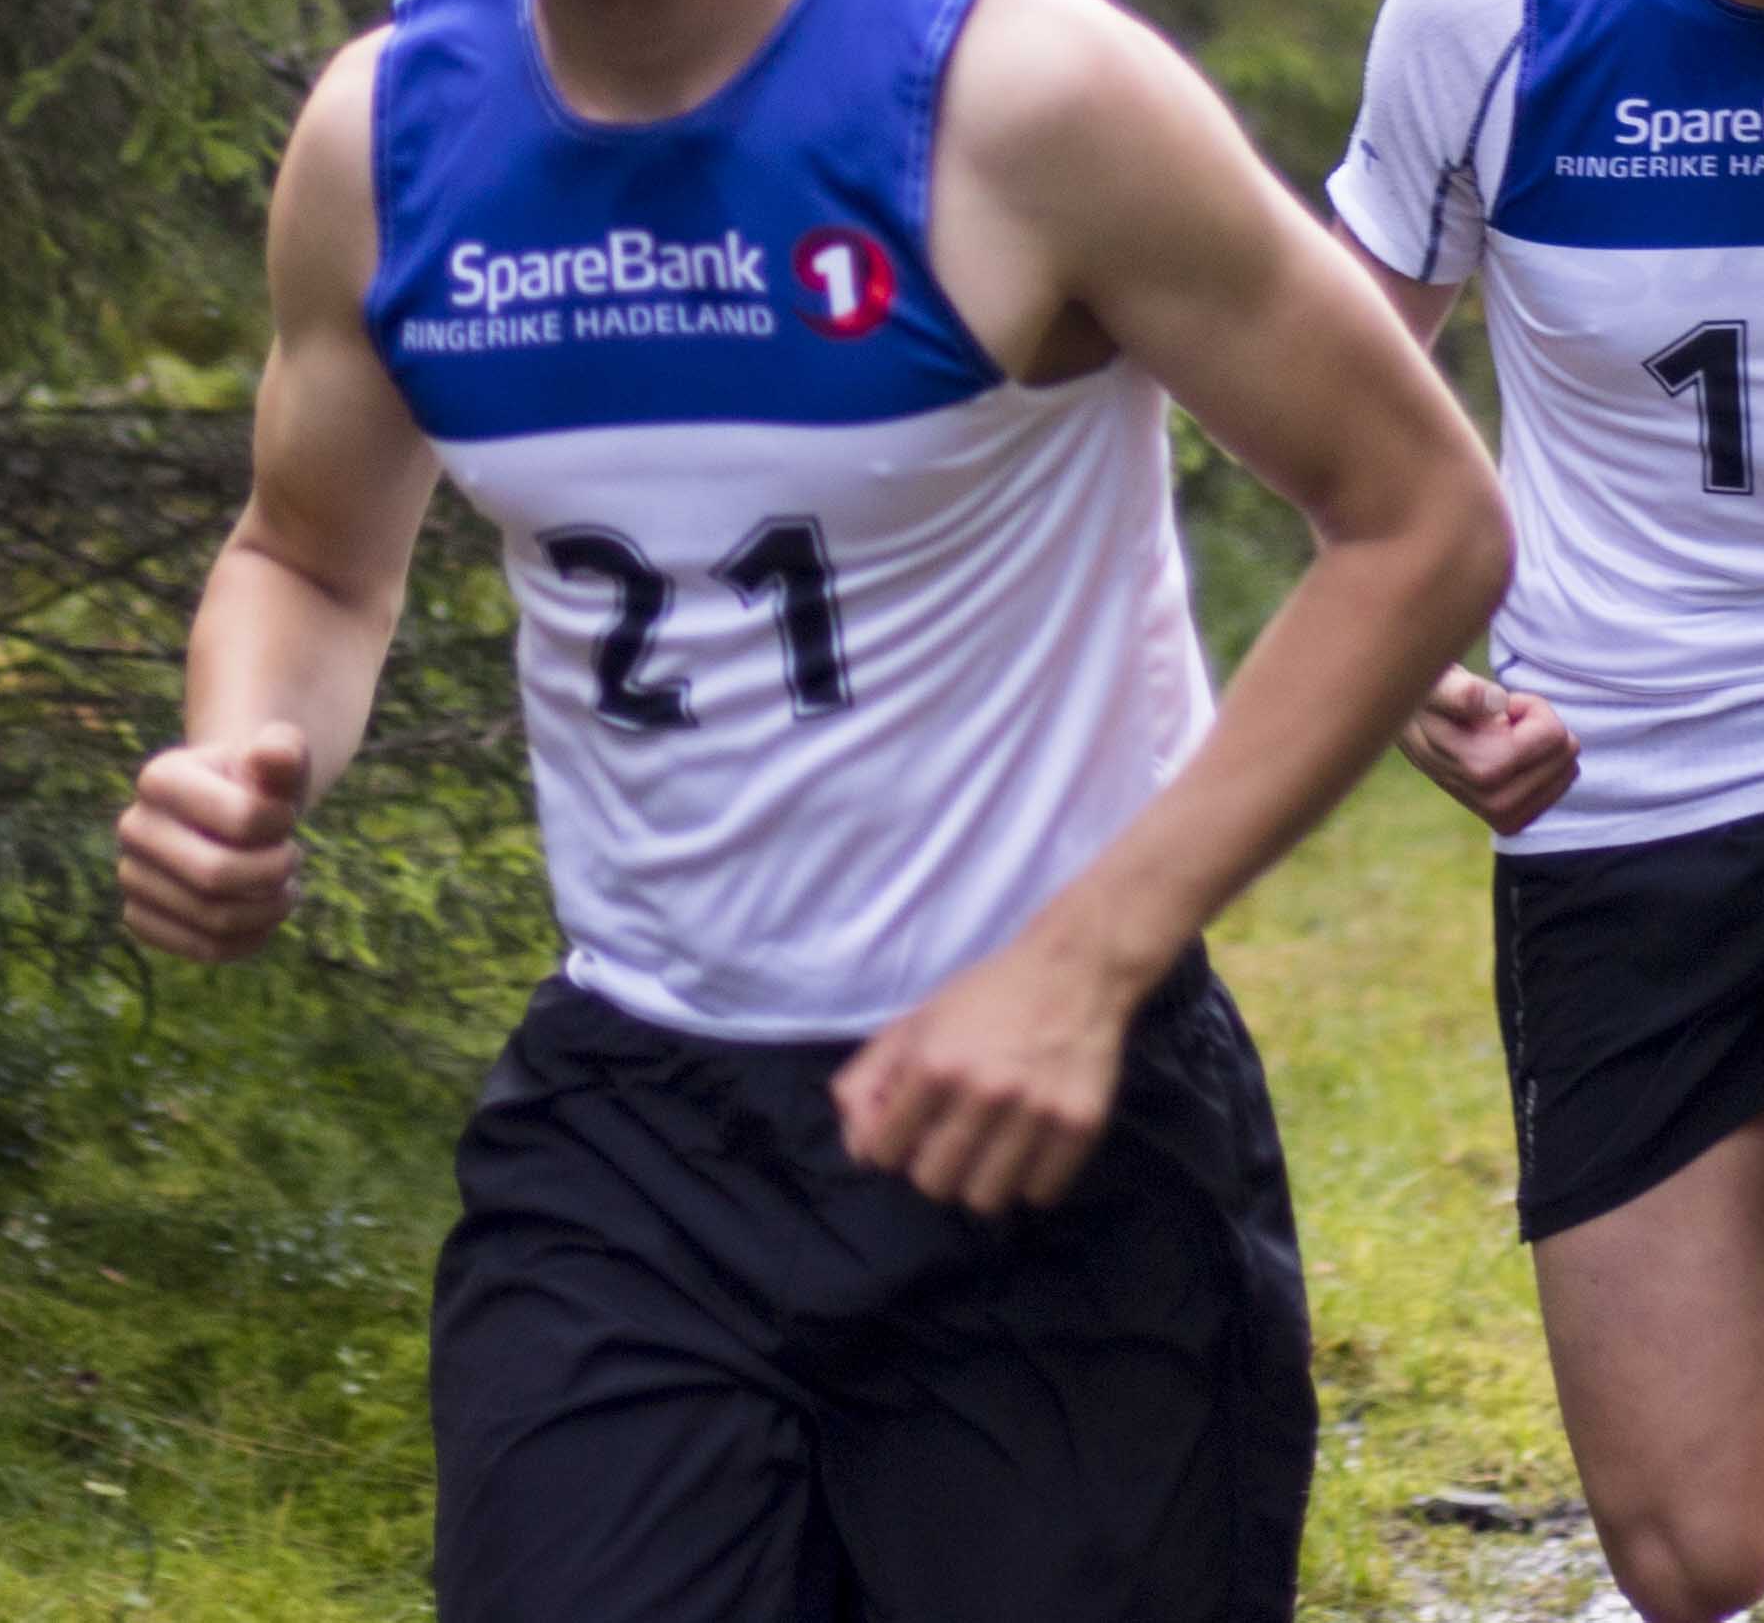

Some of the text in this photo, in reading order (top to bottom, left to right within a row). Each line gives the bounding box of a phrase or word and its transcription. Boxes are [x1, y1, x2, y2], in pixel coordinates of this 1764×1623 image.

[1554, 154, 1717, 179] RINGERIKE
[449, 229, 767, 314] SpareBank
[401, 301, 776, 353] RINGERIKE HADELAND
[536, 514, 855, 733] 21
